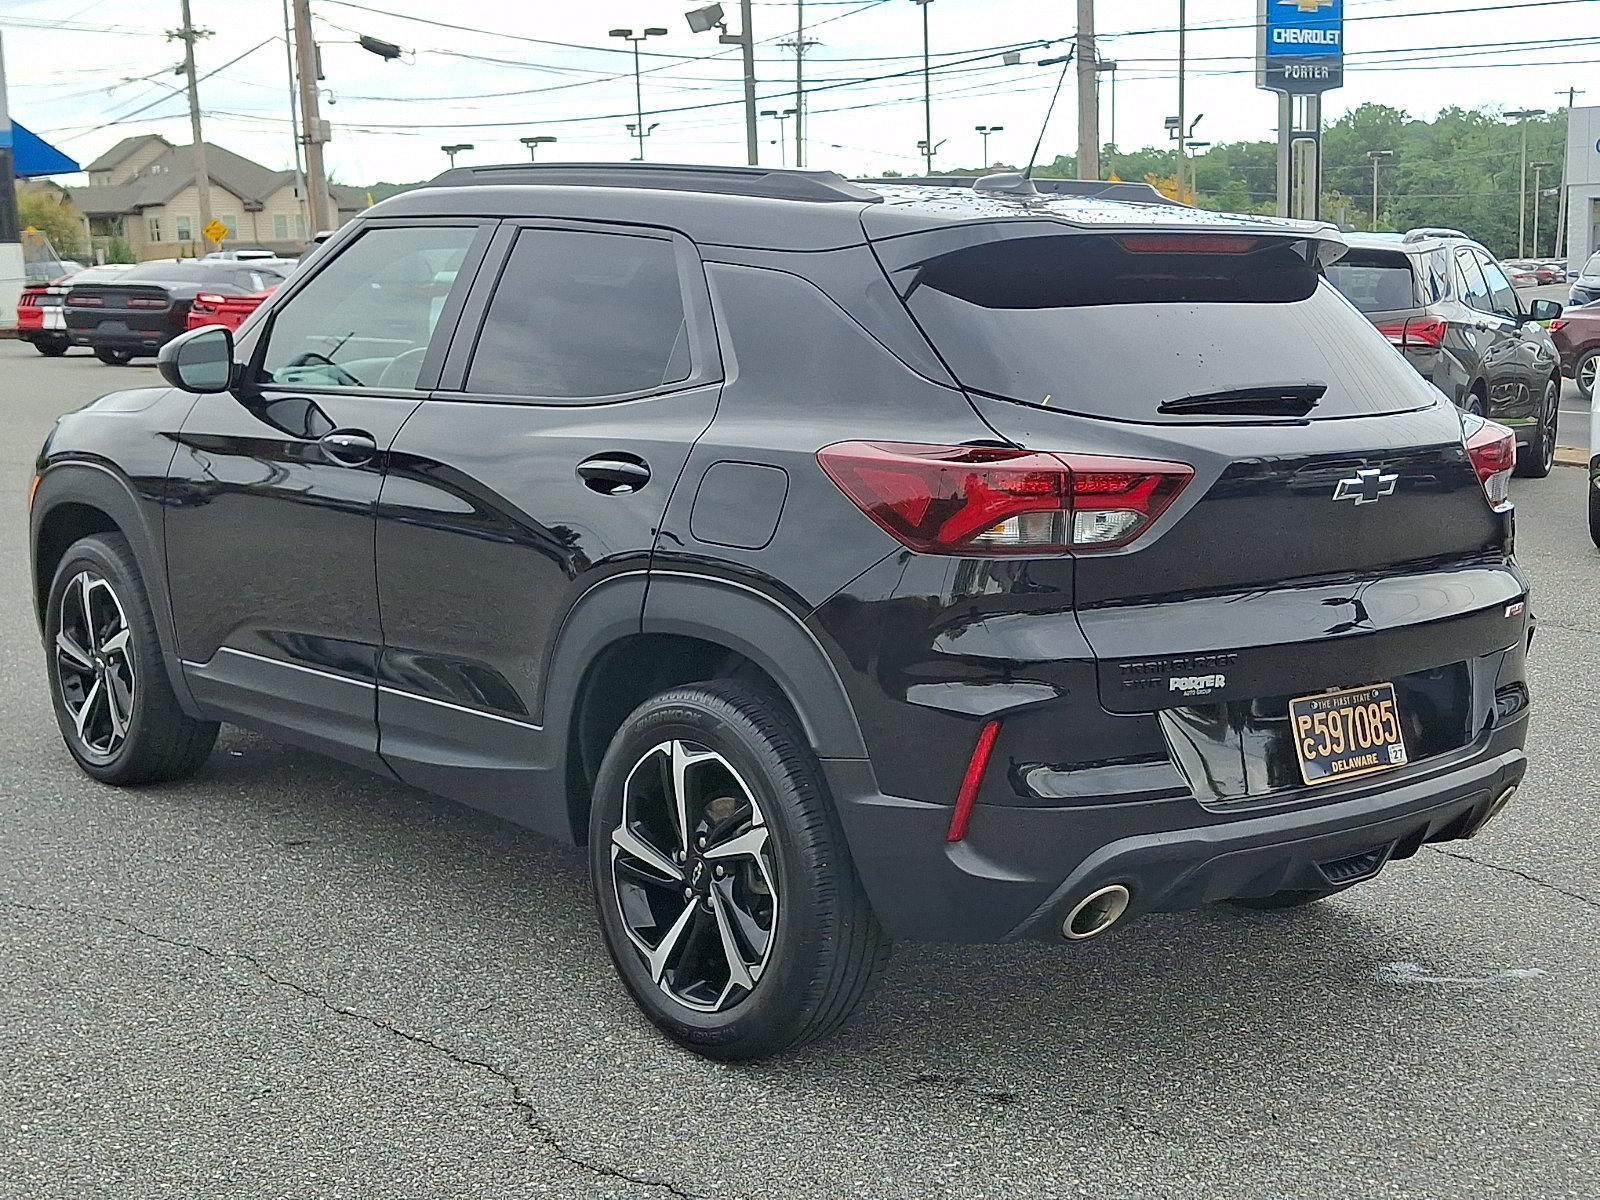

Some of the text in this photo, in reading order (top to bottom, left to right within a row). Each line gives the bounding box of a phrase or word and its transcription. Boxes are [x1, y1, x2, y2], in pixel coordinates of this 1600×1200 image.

[1273, 28, 1340, 44] CHEVROLET
[1284, 65, 1329, 79] PORTER
[1169, 674, 1226, 692] PORTER
[1318, 693, 1371, 710] THE FIRST STATE
[1392, 748, 1403, 760] 27
[1332, 753, 1379, 773] DELAWARE
